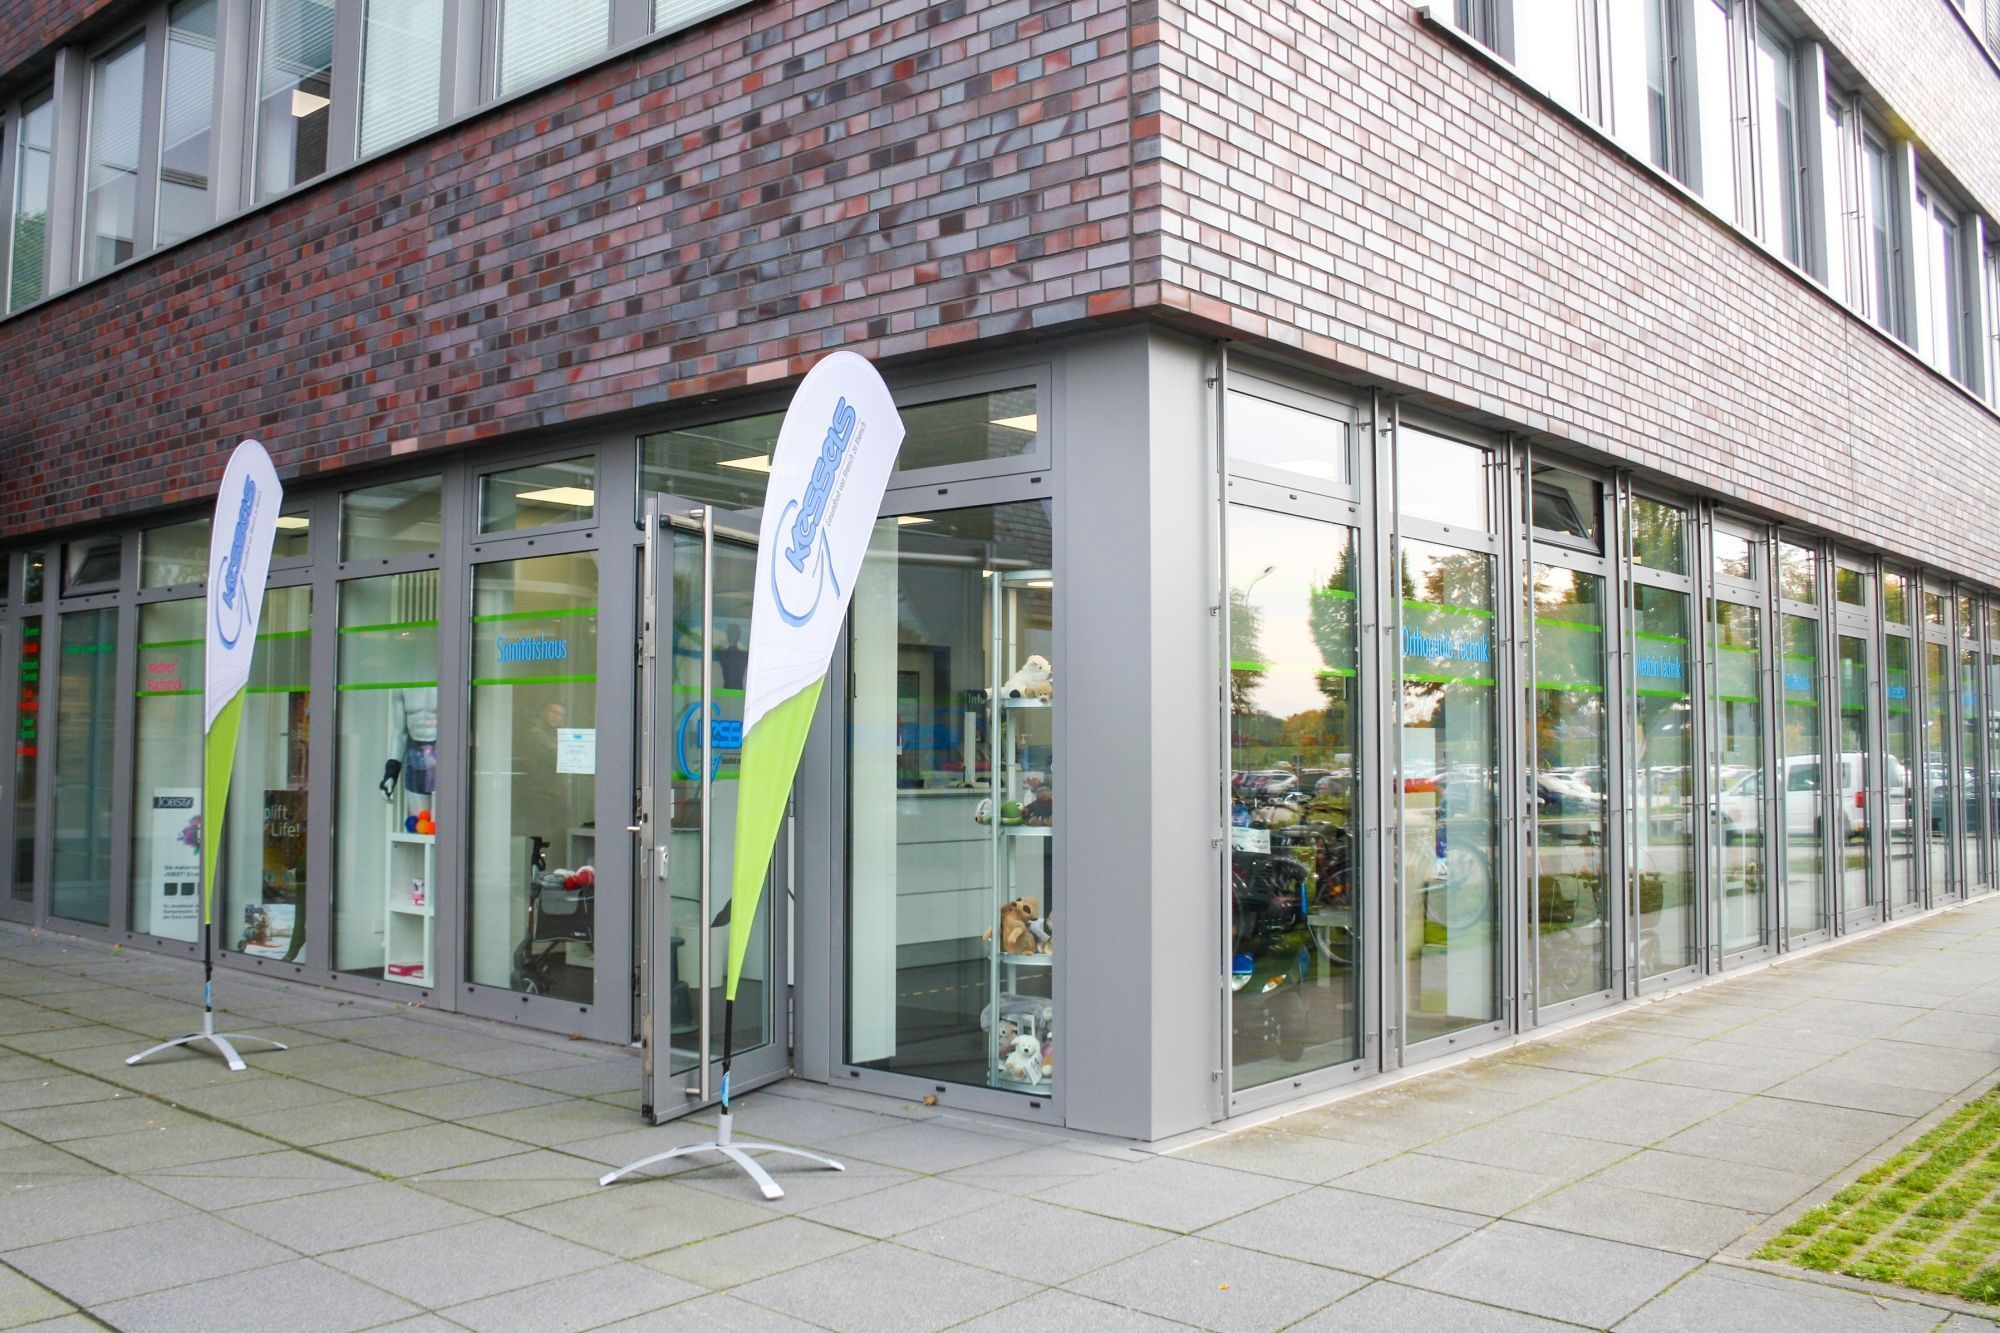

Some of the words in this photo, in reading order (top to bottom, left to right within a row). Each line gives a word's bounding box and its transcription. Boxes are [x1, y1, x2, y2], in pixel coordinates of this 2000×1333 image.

[785, 396, 856, 573] Kessels
[825, 490, 841, 527] Gesundheit
[838, 477, 846, 491] von
[842, 453, 856, 480] Mensch
[854, 421, 867, 445] Mensch
[496, 631, 568, 663] Sanitätshaus
[1456, 632, 1488, 662] Technik
[271, 822, 300, 838] Life!
